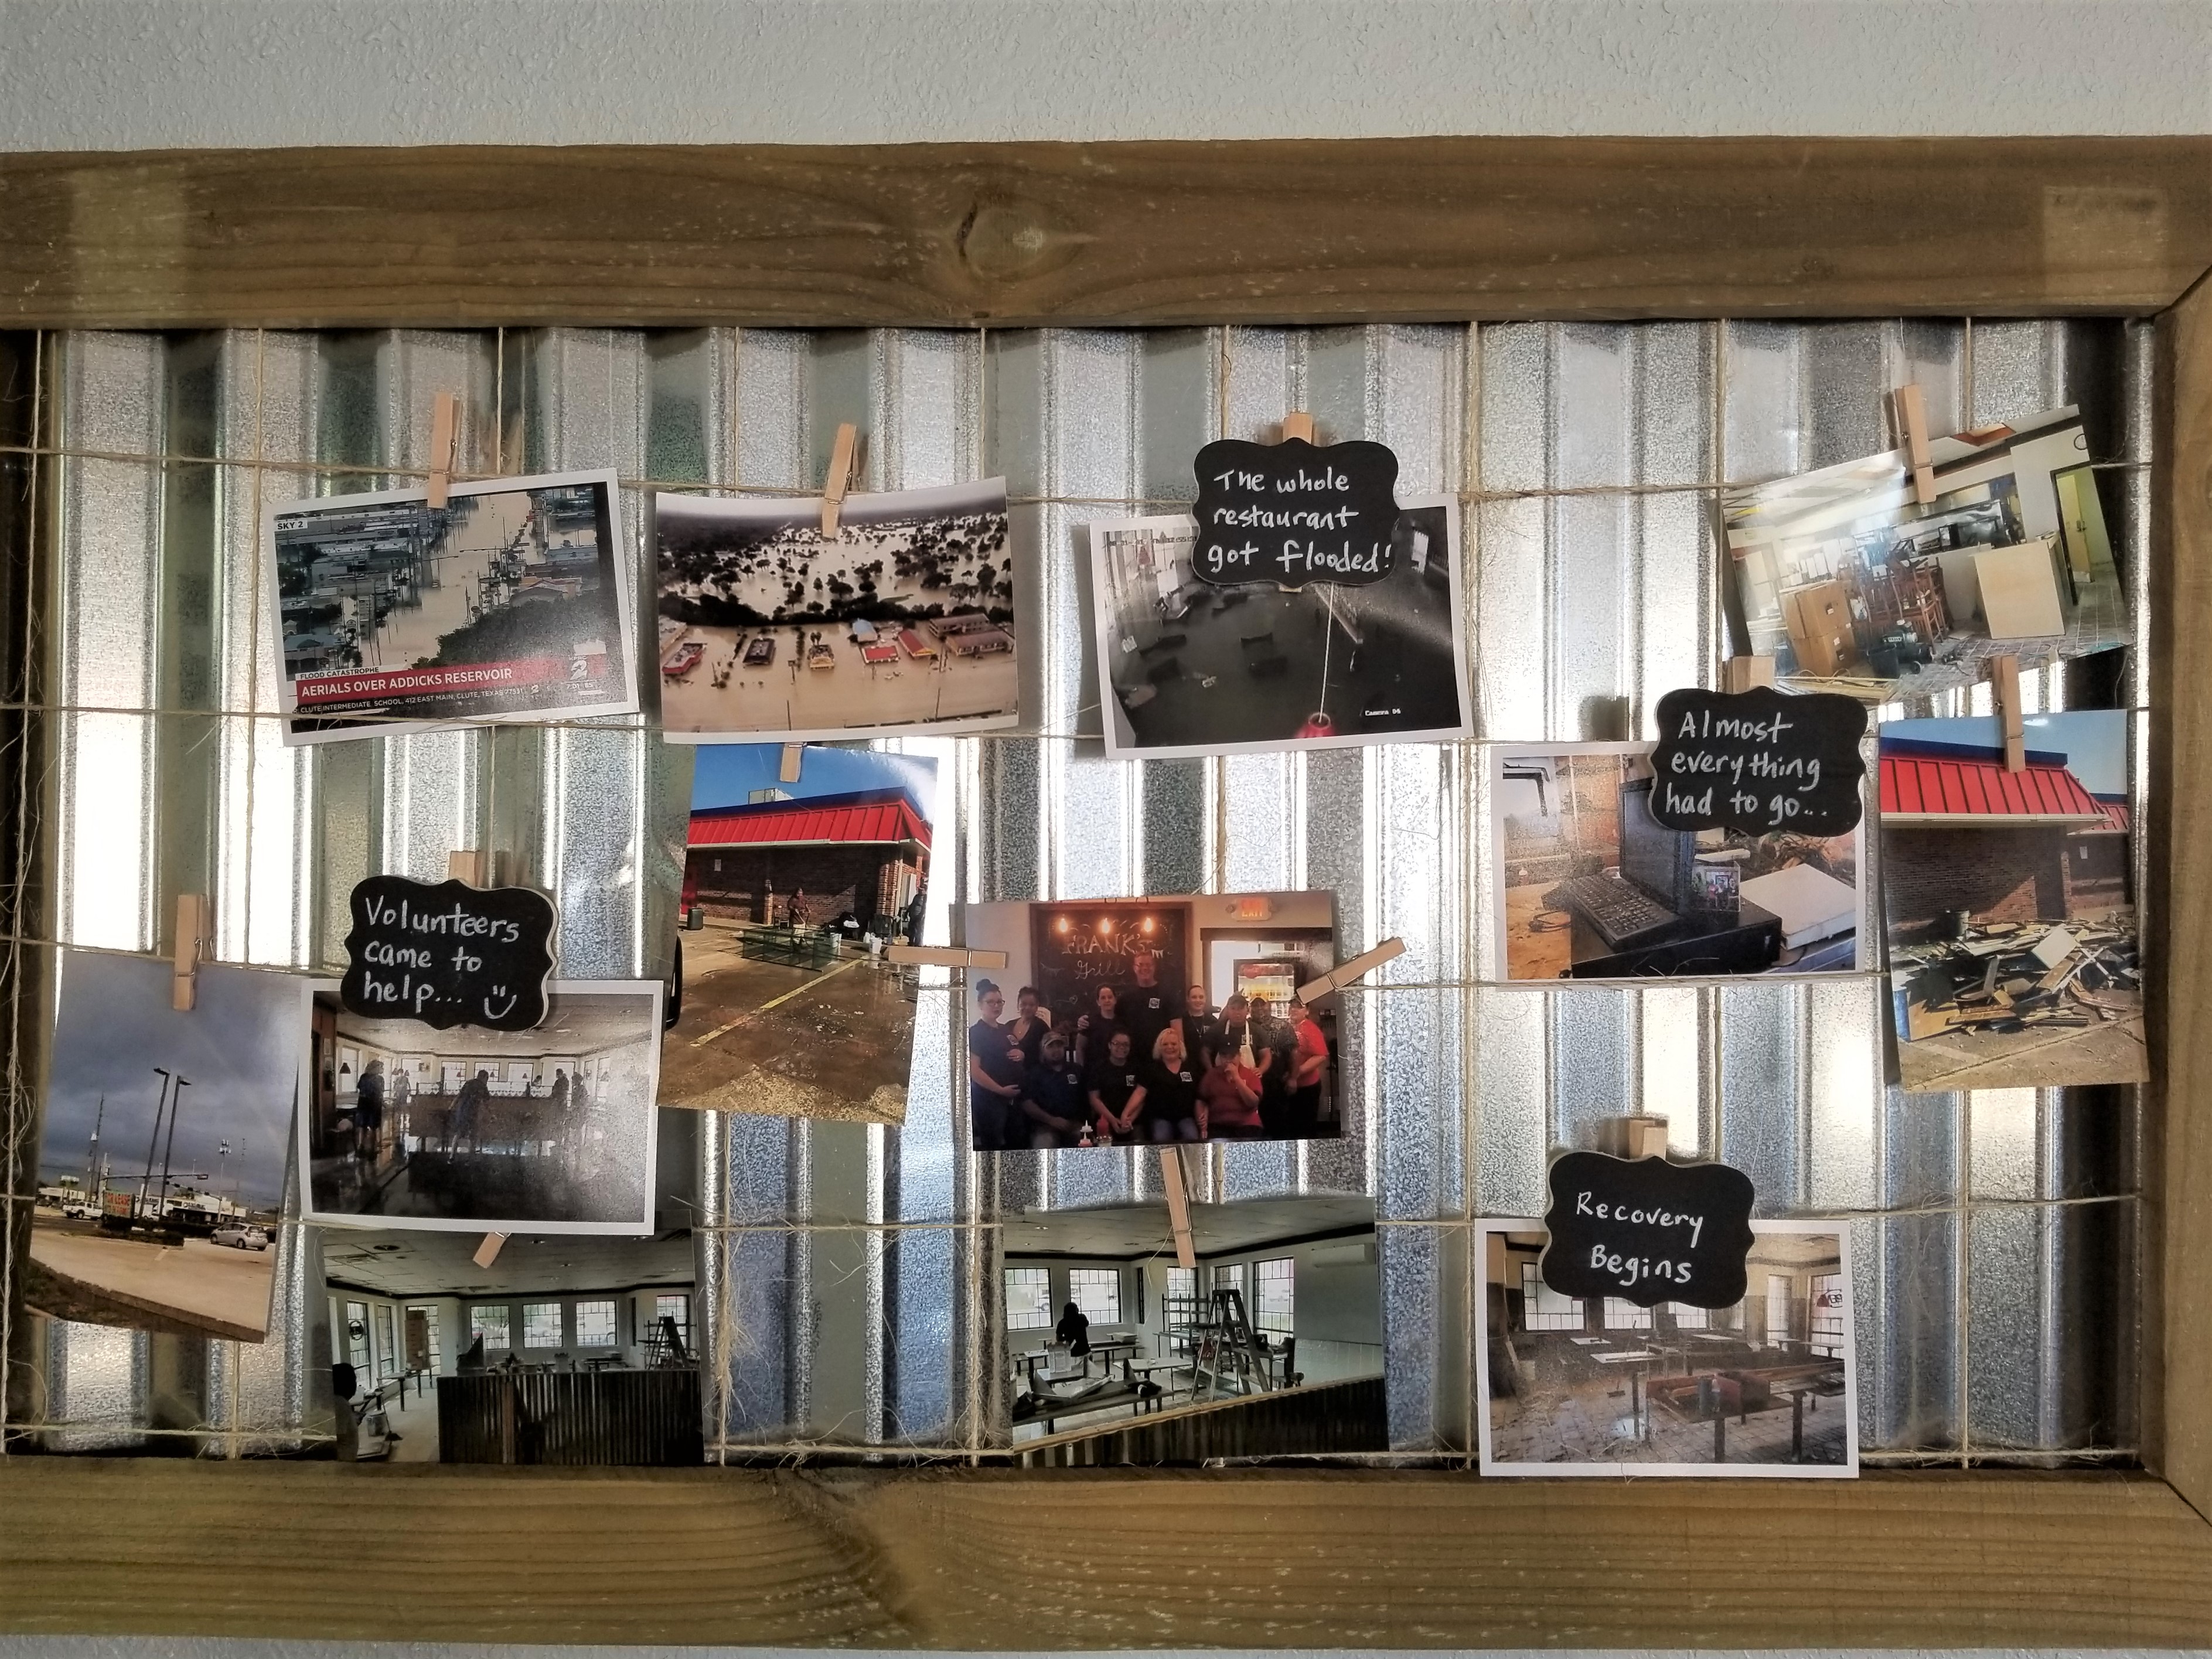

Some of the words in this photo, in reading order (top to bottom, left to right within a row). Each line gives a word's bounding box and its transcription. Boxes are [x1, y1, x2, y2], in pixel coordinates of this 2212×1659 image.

[1214, 469, 1265, 492] The
[1276, 466, 1349, 493] whole
[277, 522, 295, 530] SKY
[1214, 505, 1359, 530] restaurant
[1208, 540, 1259, 573] got
[1275, 540, 1392, 573] flooded!
[302, 682, 351, 697] AERIALS
[353, 679, 386, 692] OVER
[389, 673, 442, 689] ADDICKS
[445, 669, 513, 684] RESERVOIR
[327, 667, 379, 677] CATASTROPHE
[323, 701, 371, 711] INTERMEDIATE
[374, 699, 404, 707] SCHOOL,
[457, 691, 480, 700] CLUTE,
[1678, 710, 1793, 743] Almost
[1671, 750, 1821, 791] everything
[1665, 782, 1712, 816] had
[1730, 789, 1758, 814] to
[365, 895, 519, 943] Volunteers
[364, 941, 432, 968] came
[451, 946, 483, 972] to
[1075, 960, 1126, 980] Grill
[364, 970, 462, 1014] help...
[1576, 1191, 1703, 1248] Recovery
[1590, 1244, 1692, 1286] Begins
